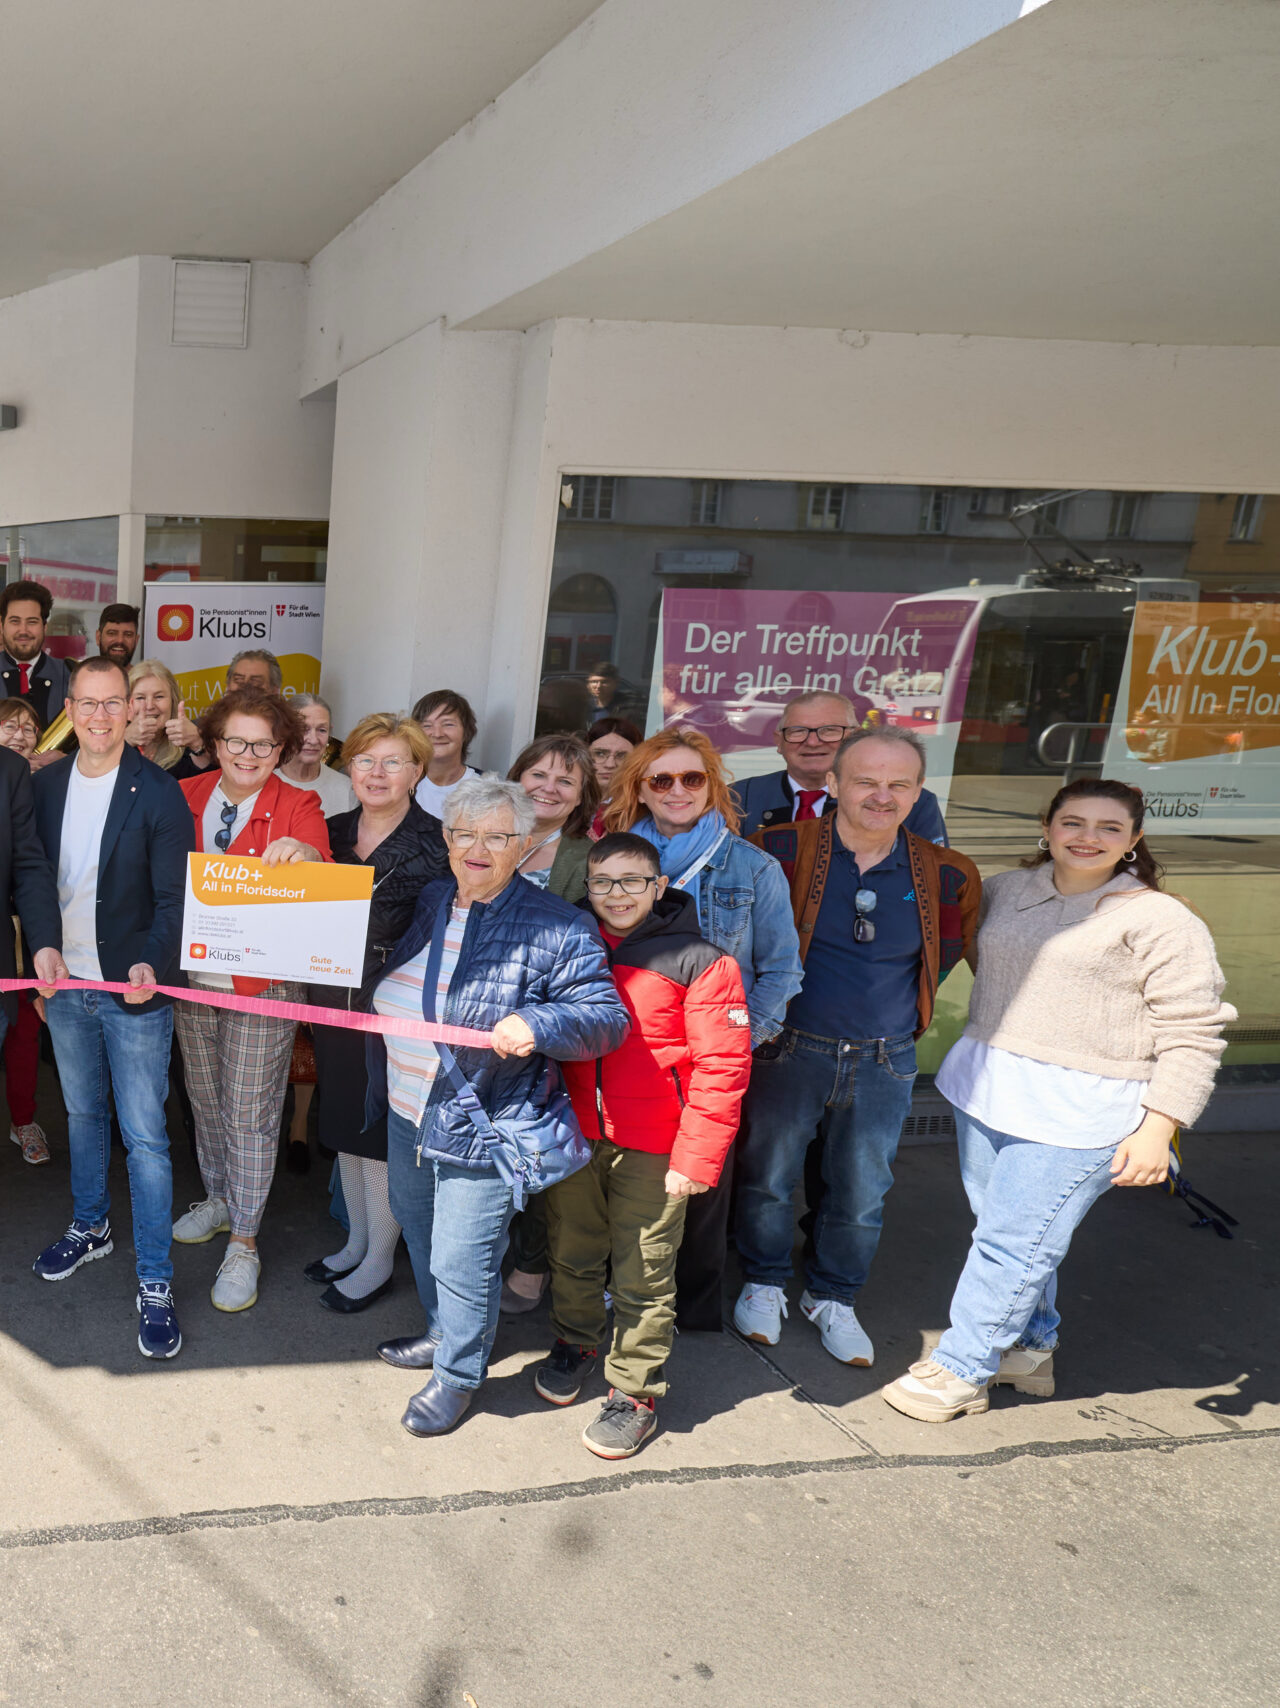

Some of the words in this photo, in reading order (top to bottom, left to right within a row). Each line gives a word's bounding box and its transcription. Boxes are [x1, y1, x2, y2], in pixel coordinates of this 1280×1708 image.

[199, 616, 266, 639] Klubs
[684, 623, 747, 654] Der
[756, 624, 923, 663] Treffpunkt
[679, 664, 727, 694] für
[734, 665, 793, 695] alle
[801, 666, 841, 695] im
[853, 666, 950, 697] Grätzl
[1140, 684, 1181, 714] All
[1189, 685, 1217, 714] In
[1143, 798, 1199, 818] Klubs
[202, 861, 263, 881] Klub+
[201, 881, 217, 892] All
[221, 882, 232, 893] in
[236, 883, 306, 899] Floridsdorf
[208, 949, 241, 962] Klubs
[310, 955, 333, 965] Gute
[309, 965, 332, 974] neue
[333, 966, 355, 976] Zeit.
